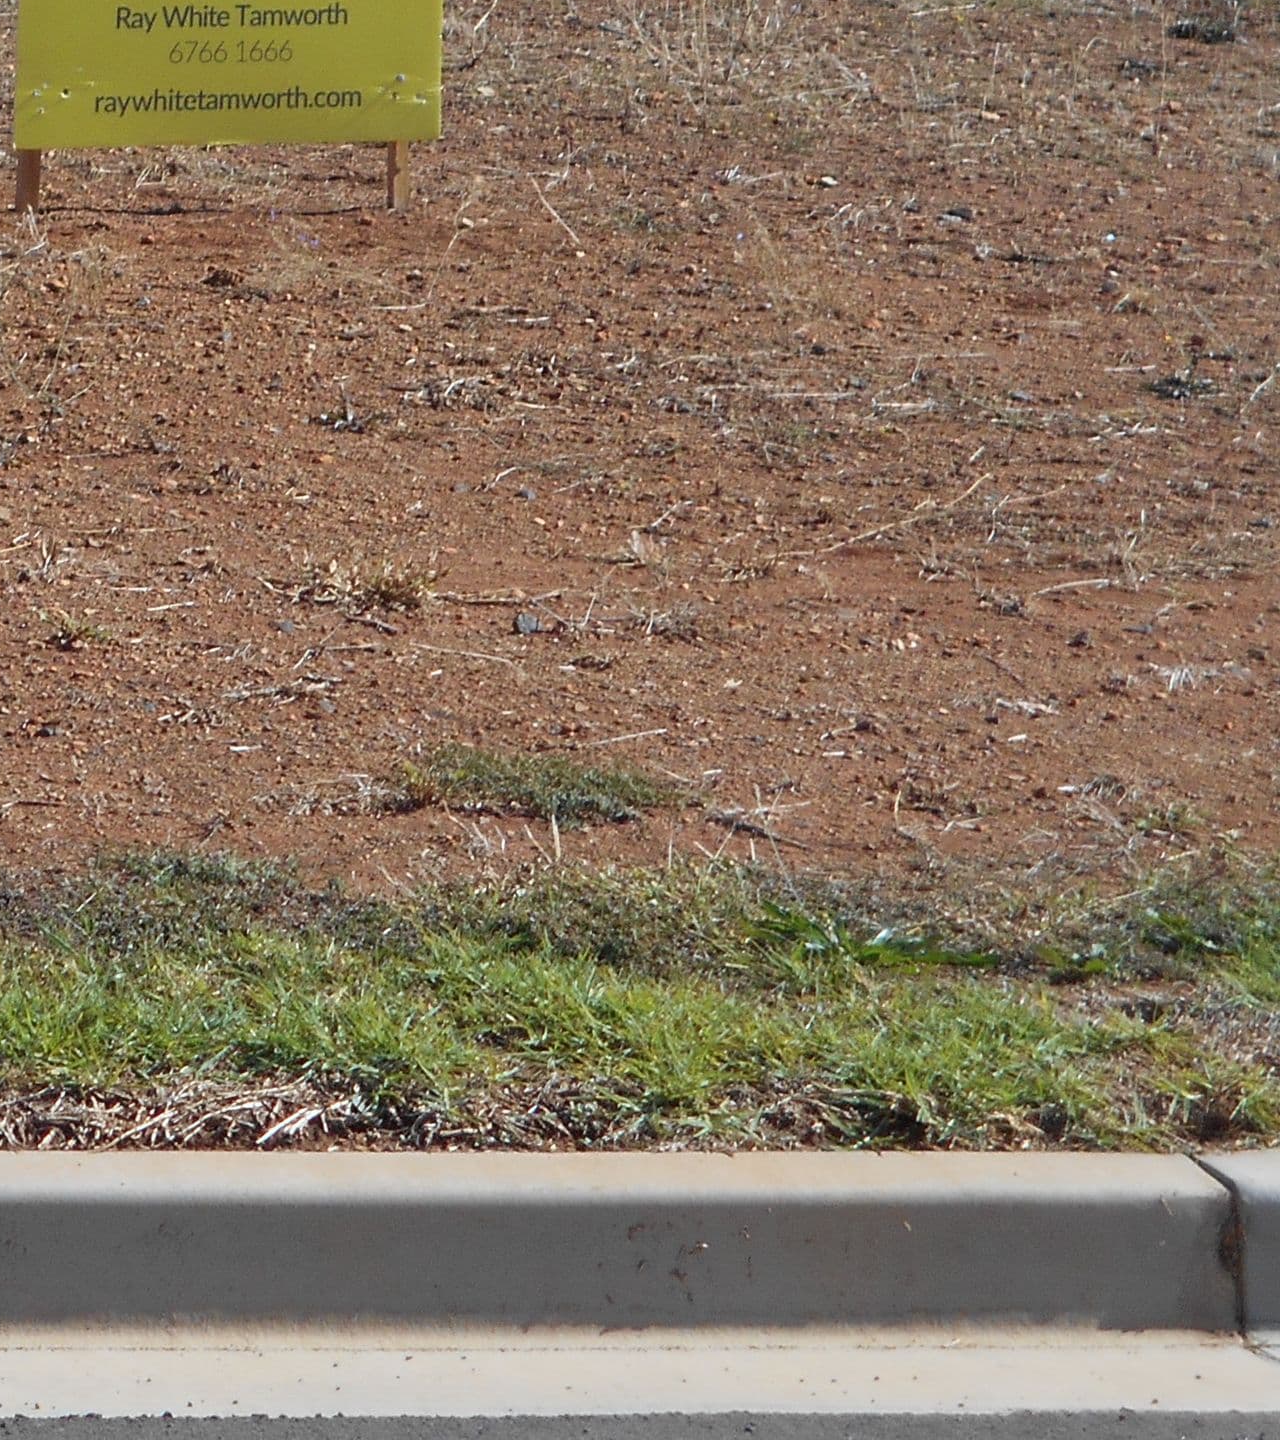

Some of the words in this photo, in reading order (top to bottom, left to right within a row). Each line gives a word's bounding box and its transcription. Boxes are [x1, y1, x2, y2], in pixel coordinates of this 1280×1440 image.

[116, 6, 157, 33] Ray
[162, 4, 230, 28] White
[235, 2, 348, 27] Tamworth
[169, 40, 228, 64] 6766
[236, 39, 293, 63] 1666
[94, 85, 362, 117] raywhitetamworth.com
